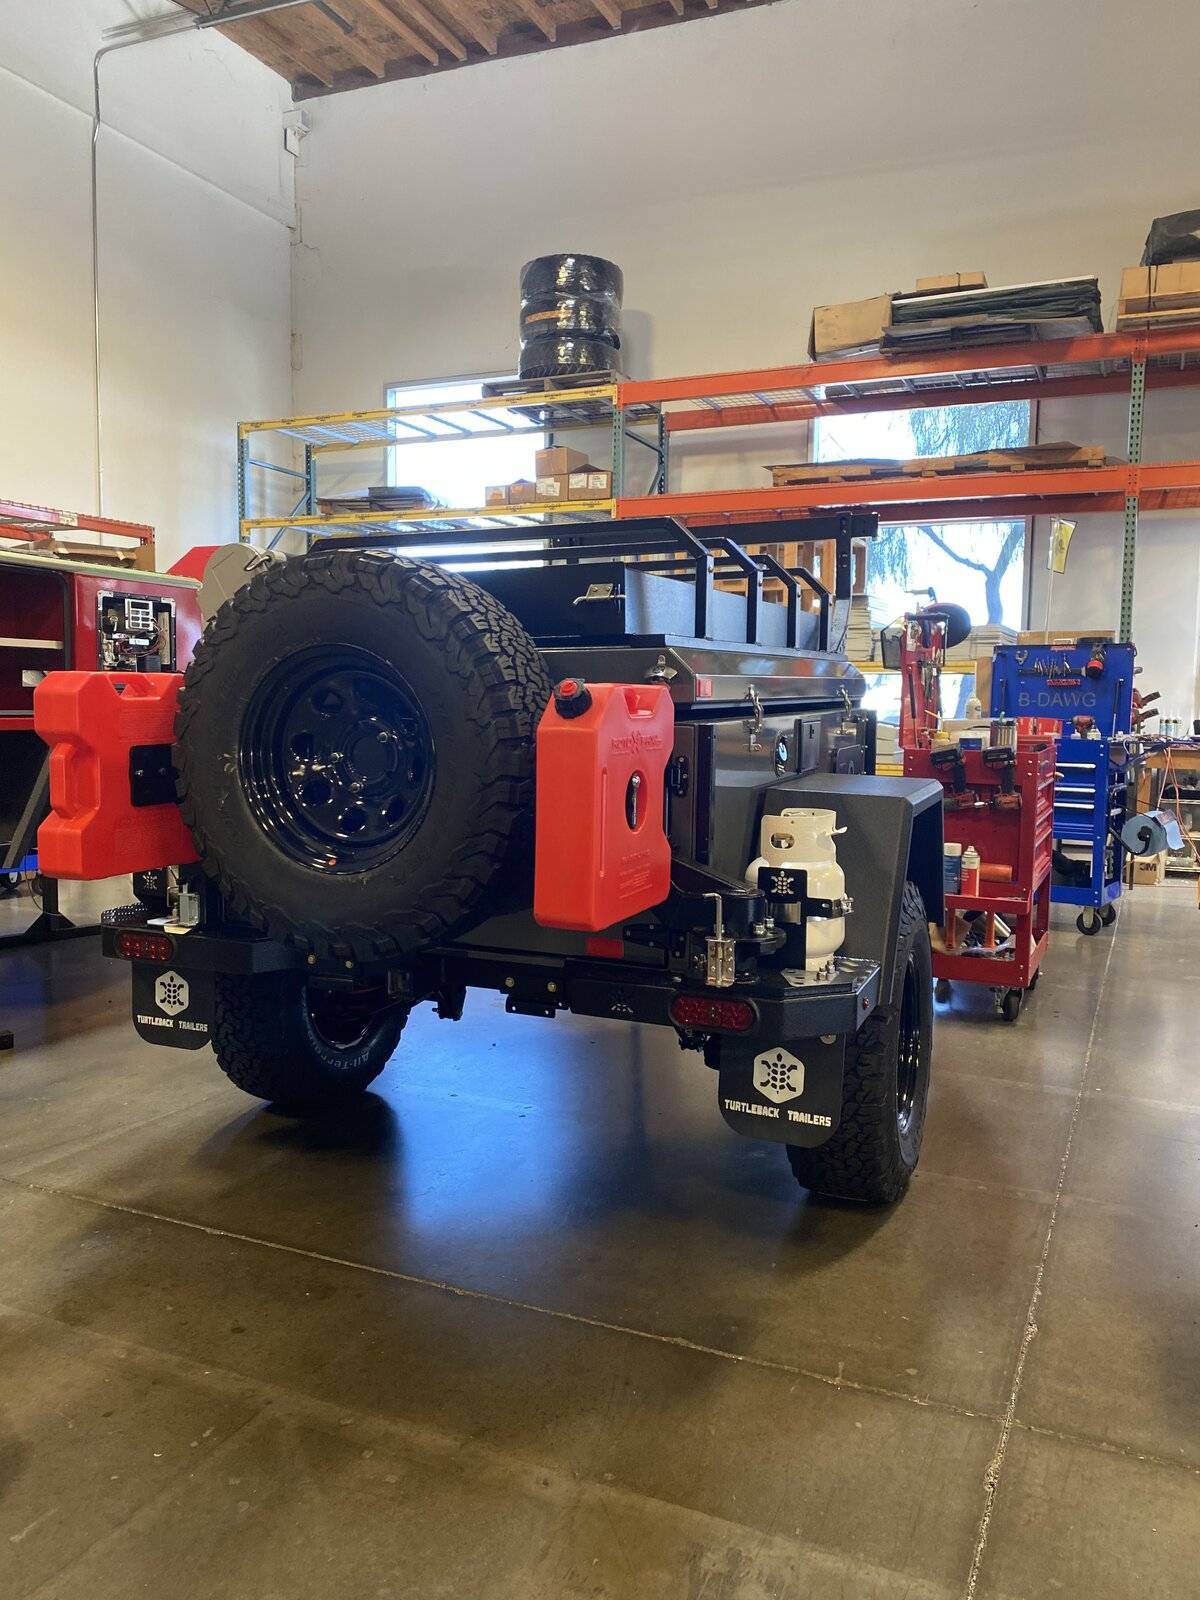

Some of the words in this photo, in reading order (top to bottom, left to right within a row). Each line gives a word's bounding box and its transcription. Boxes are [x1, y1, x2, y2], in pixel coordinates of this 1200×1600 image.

[1018, 691, 1097, 707] B-DAWG
[1139, 862, 1157, 872] 3M
[136, 1015, 174, 1028] TURTLEBACK
[178, 1020, 208, 1032] TRAILERS
[724, 1099, 780, 1118] TURTLEBACK
[787, 1110, 832, 1127] TRAILERS
